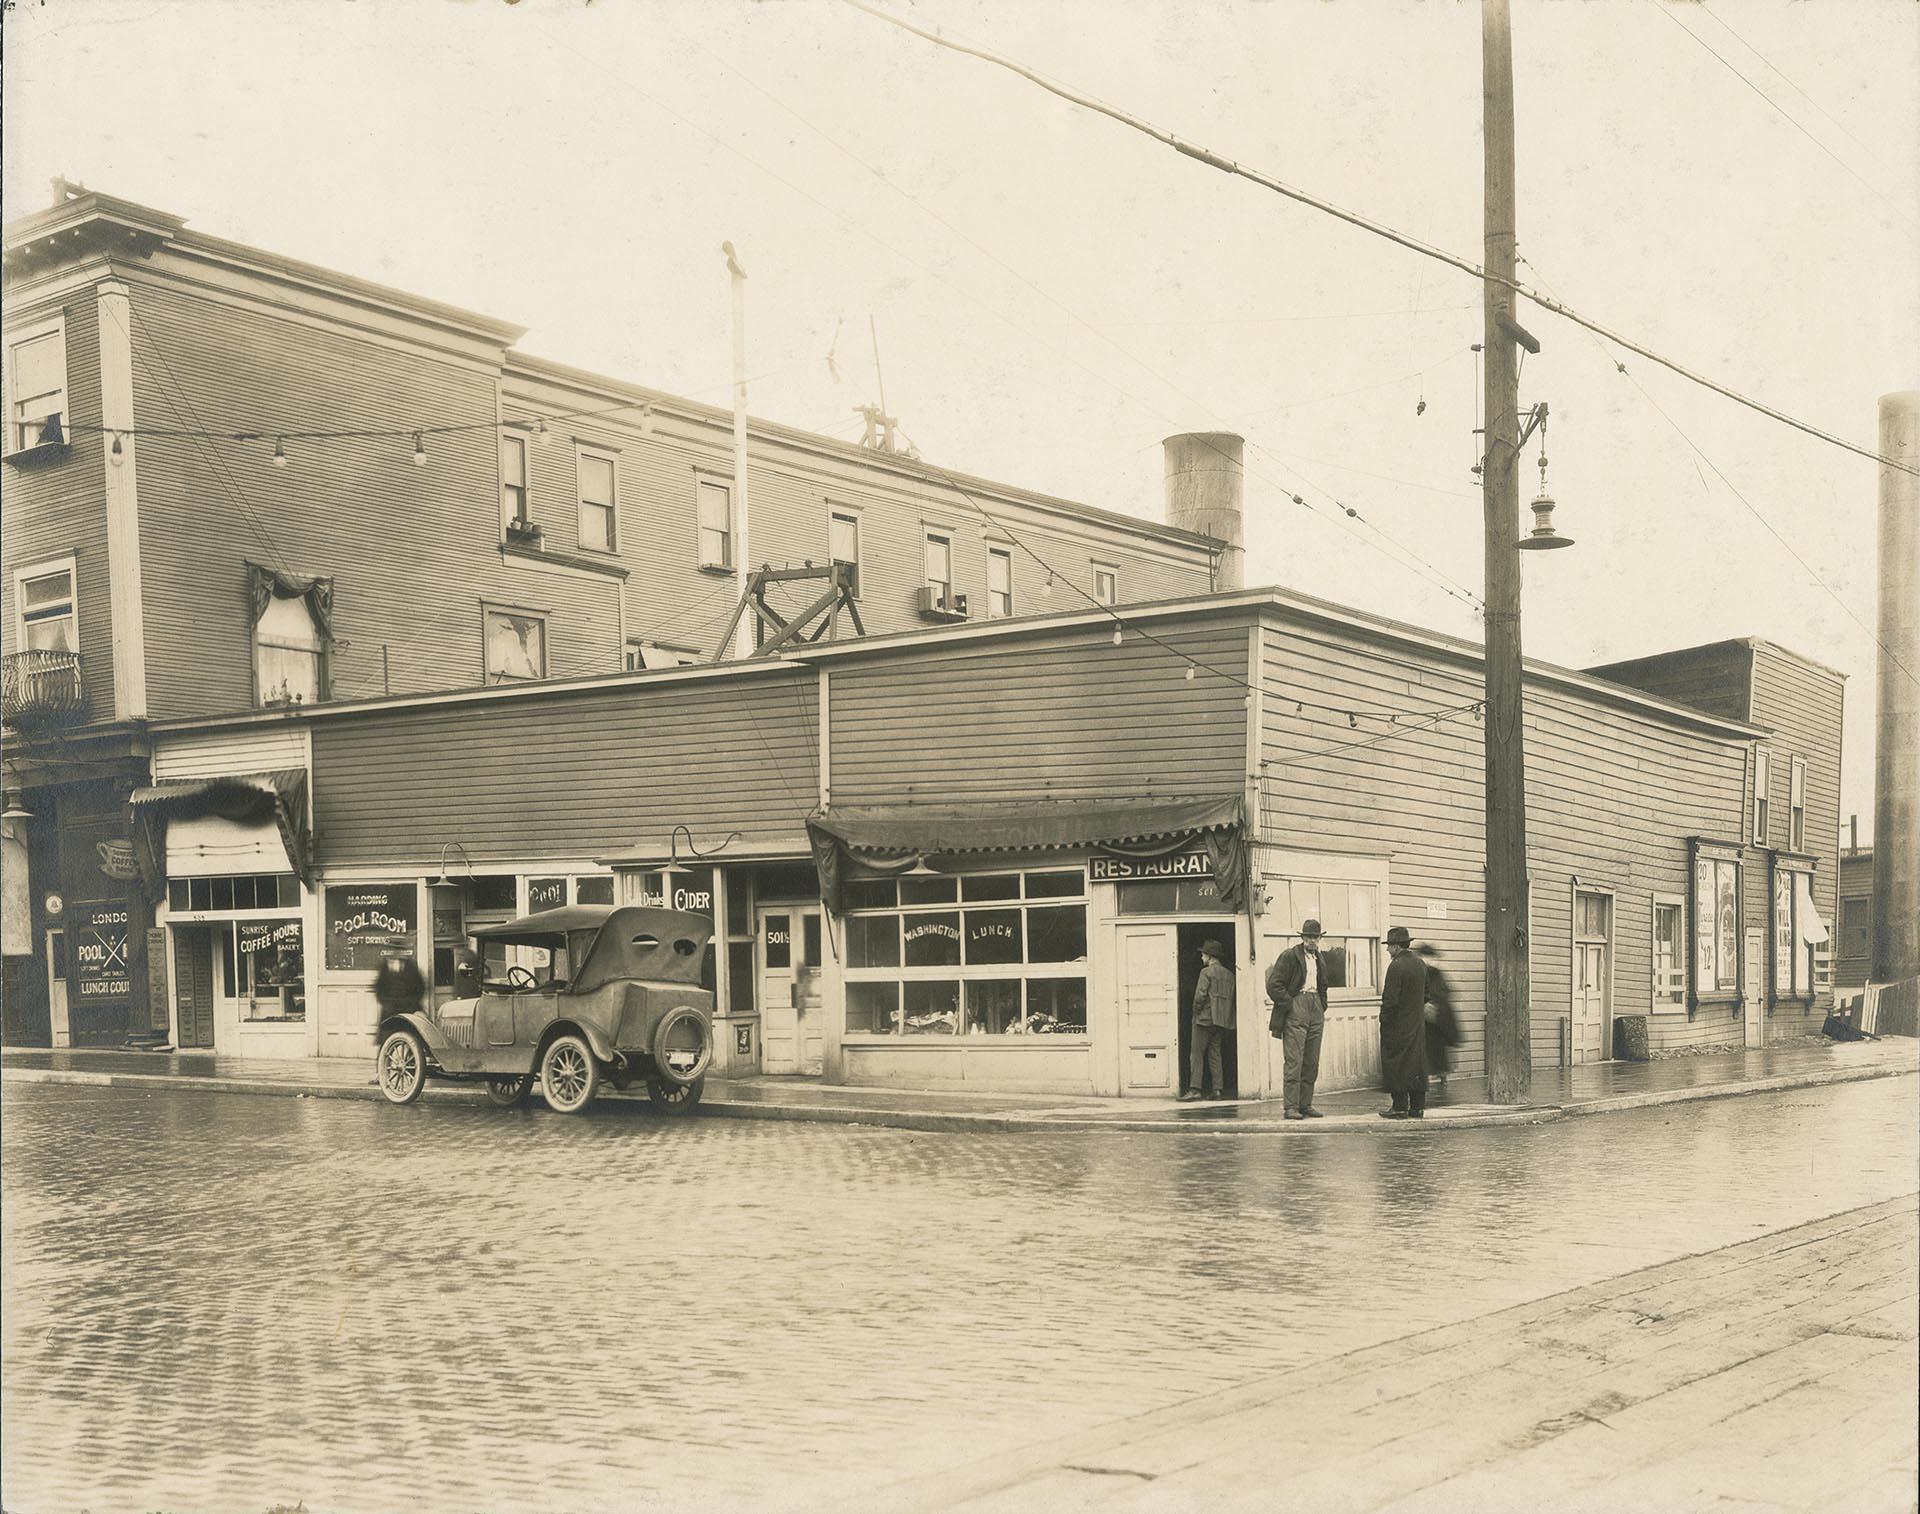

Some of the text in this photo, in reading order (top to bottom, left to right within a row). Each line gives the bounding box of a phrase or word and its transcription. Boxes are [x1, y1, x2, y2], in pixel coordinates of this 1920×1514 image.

[1094, 854, 1212, 878] RESTAURAN
[675, 888, 711, 911] CIDER
[92, 912, 127, 925] LONDO
[334, 911, 407, 933] POOL ROOM
[240, 924, 300, 953] COFFEE HOUSE
[904, 924, 1012, 942] WASHINGTON LUNCH
[78, 945, 106, 961] POOL
[81, 982, 109, 994] LUNCH
